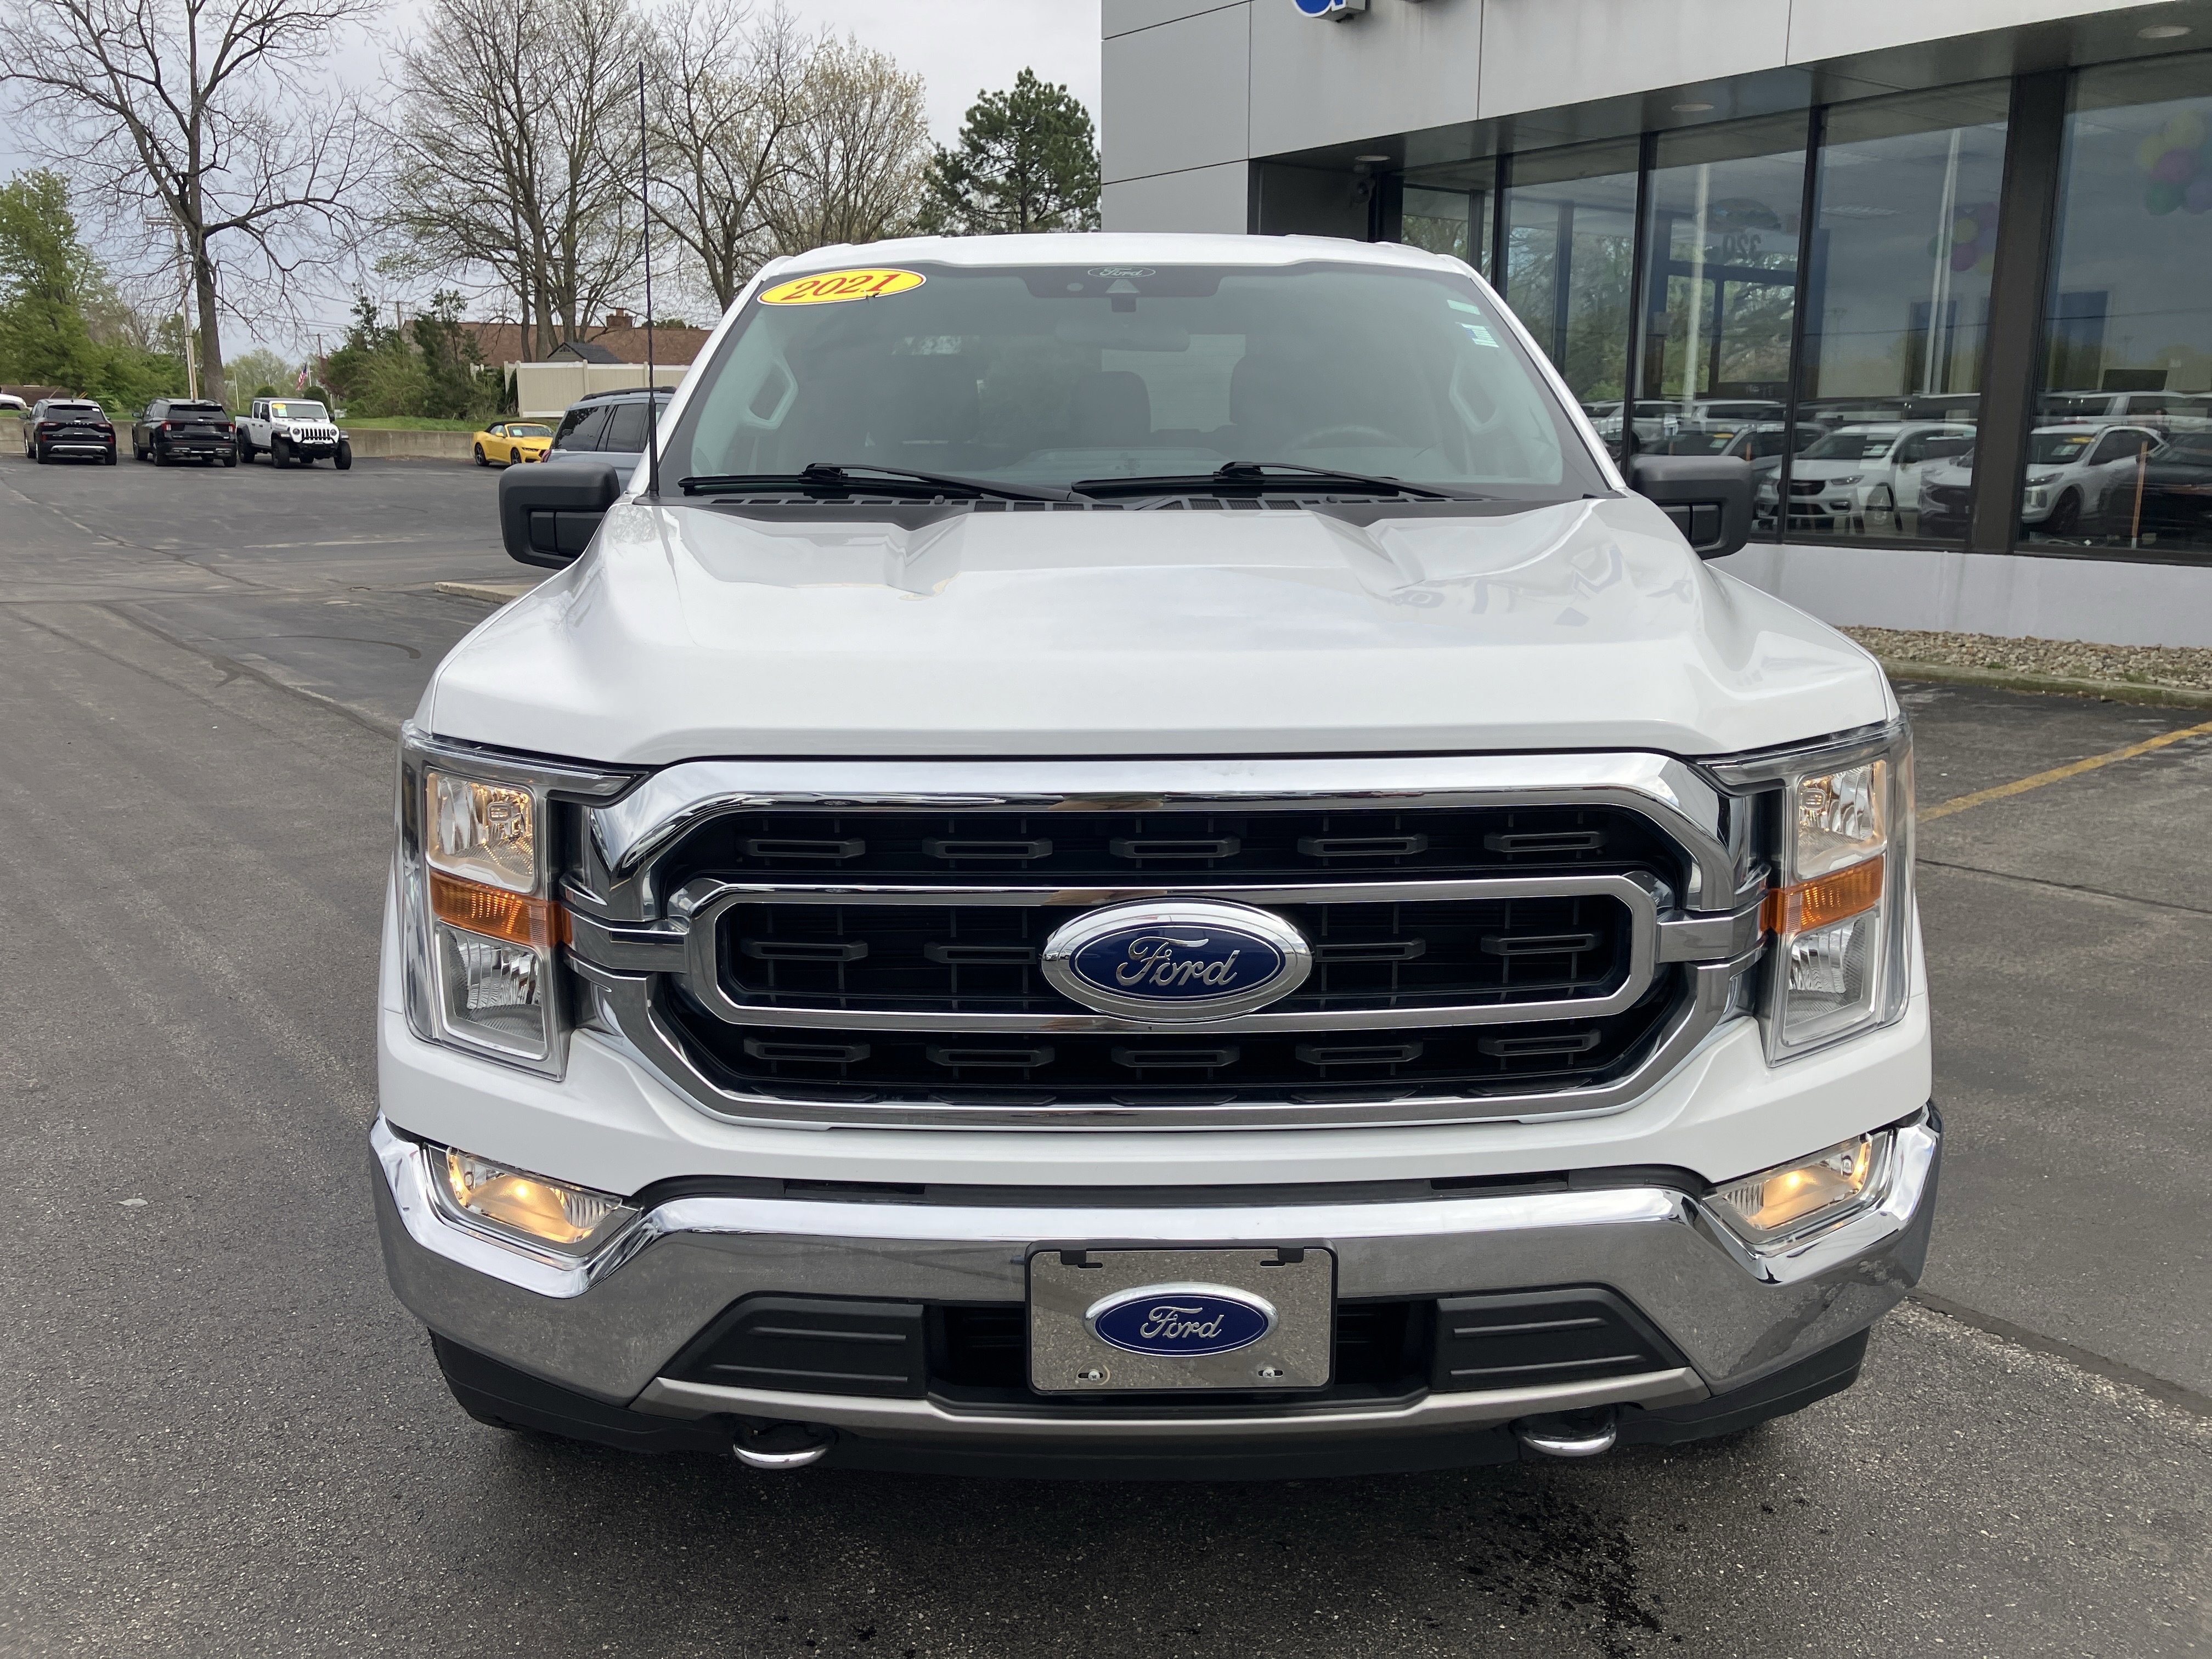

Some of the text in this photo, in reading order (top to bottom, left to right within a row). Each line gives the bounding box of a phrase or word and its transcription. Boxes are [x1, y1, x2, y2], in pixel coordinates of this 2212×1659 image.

[1099, 267, 1143, 276] Ford
[780, 274, 901, 301] 2021
[1115, 936, 1241, 986] Ford
[1139, 1305, 1225, 1339] Ford
